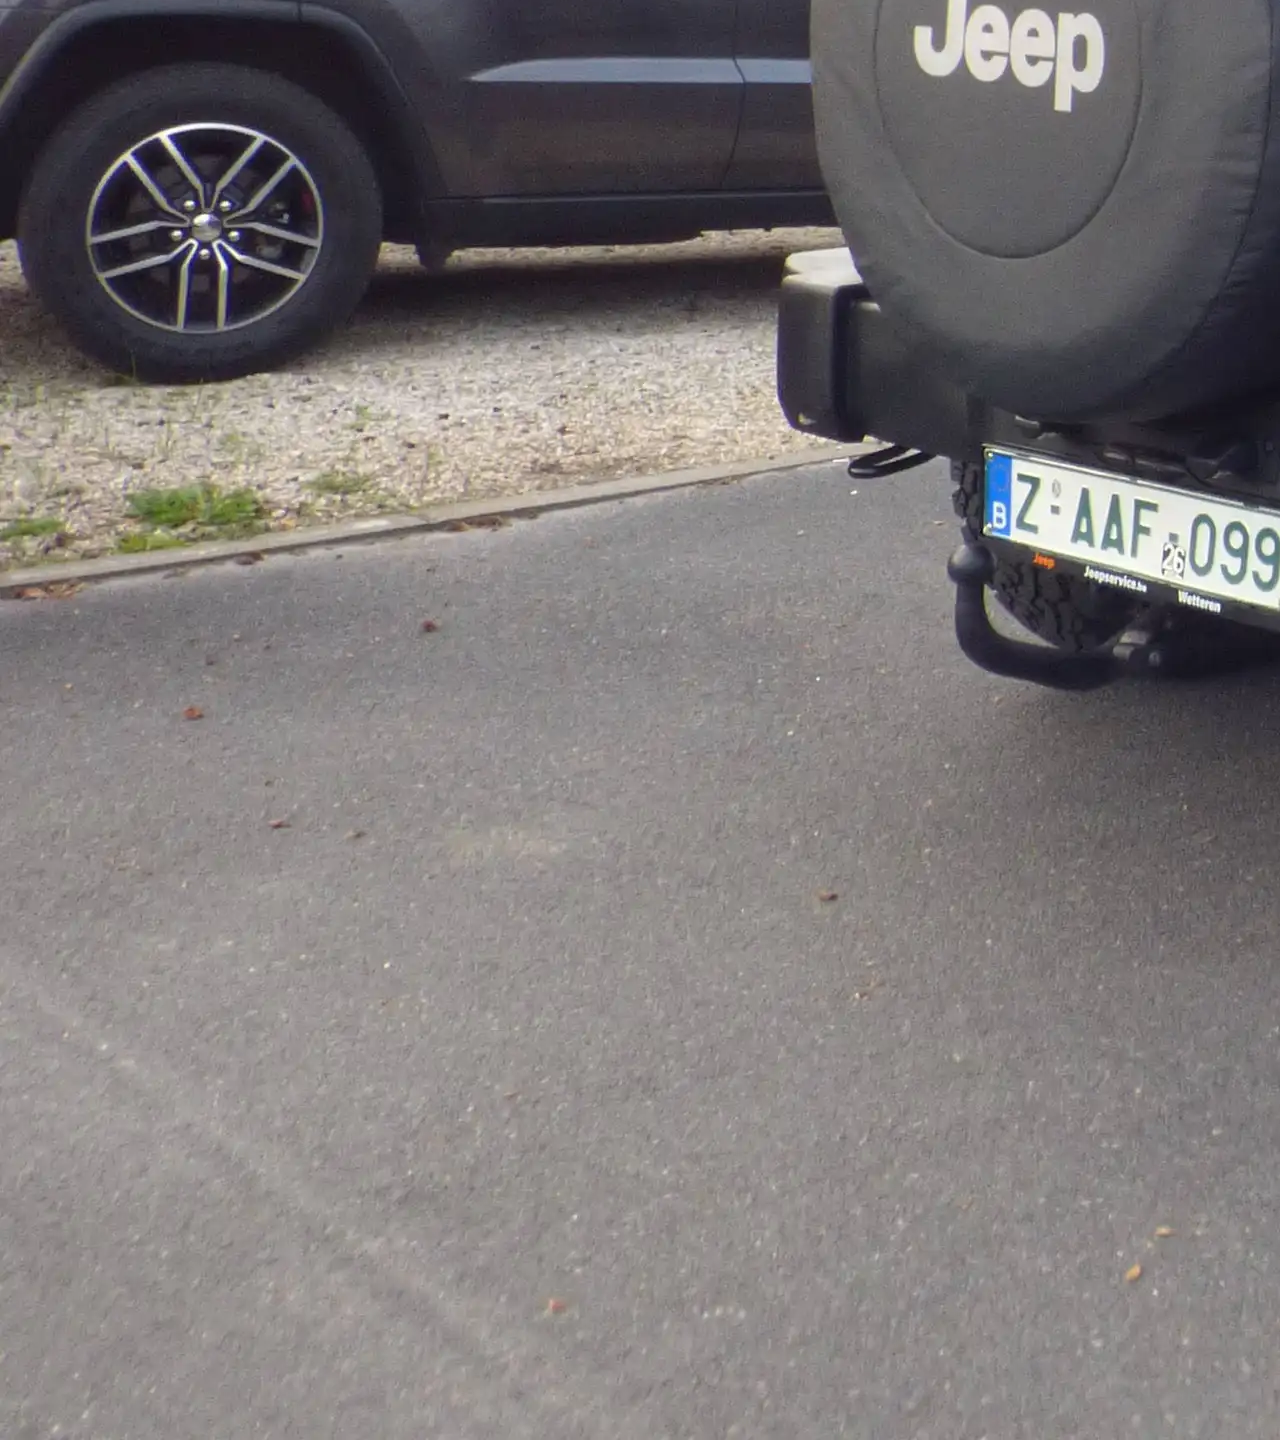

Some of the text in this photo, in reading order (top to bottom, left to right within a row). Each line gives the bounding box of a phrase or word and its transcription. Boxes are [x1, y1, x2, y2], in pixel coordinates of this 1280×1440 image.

[992, 501, 1008, 529] B
[1083, 565, 1148, 594] Jeepservice.be
[1177, 590, 1222, 614] Wetteren
